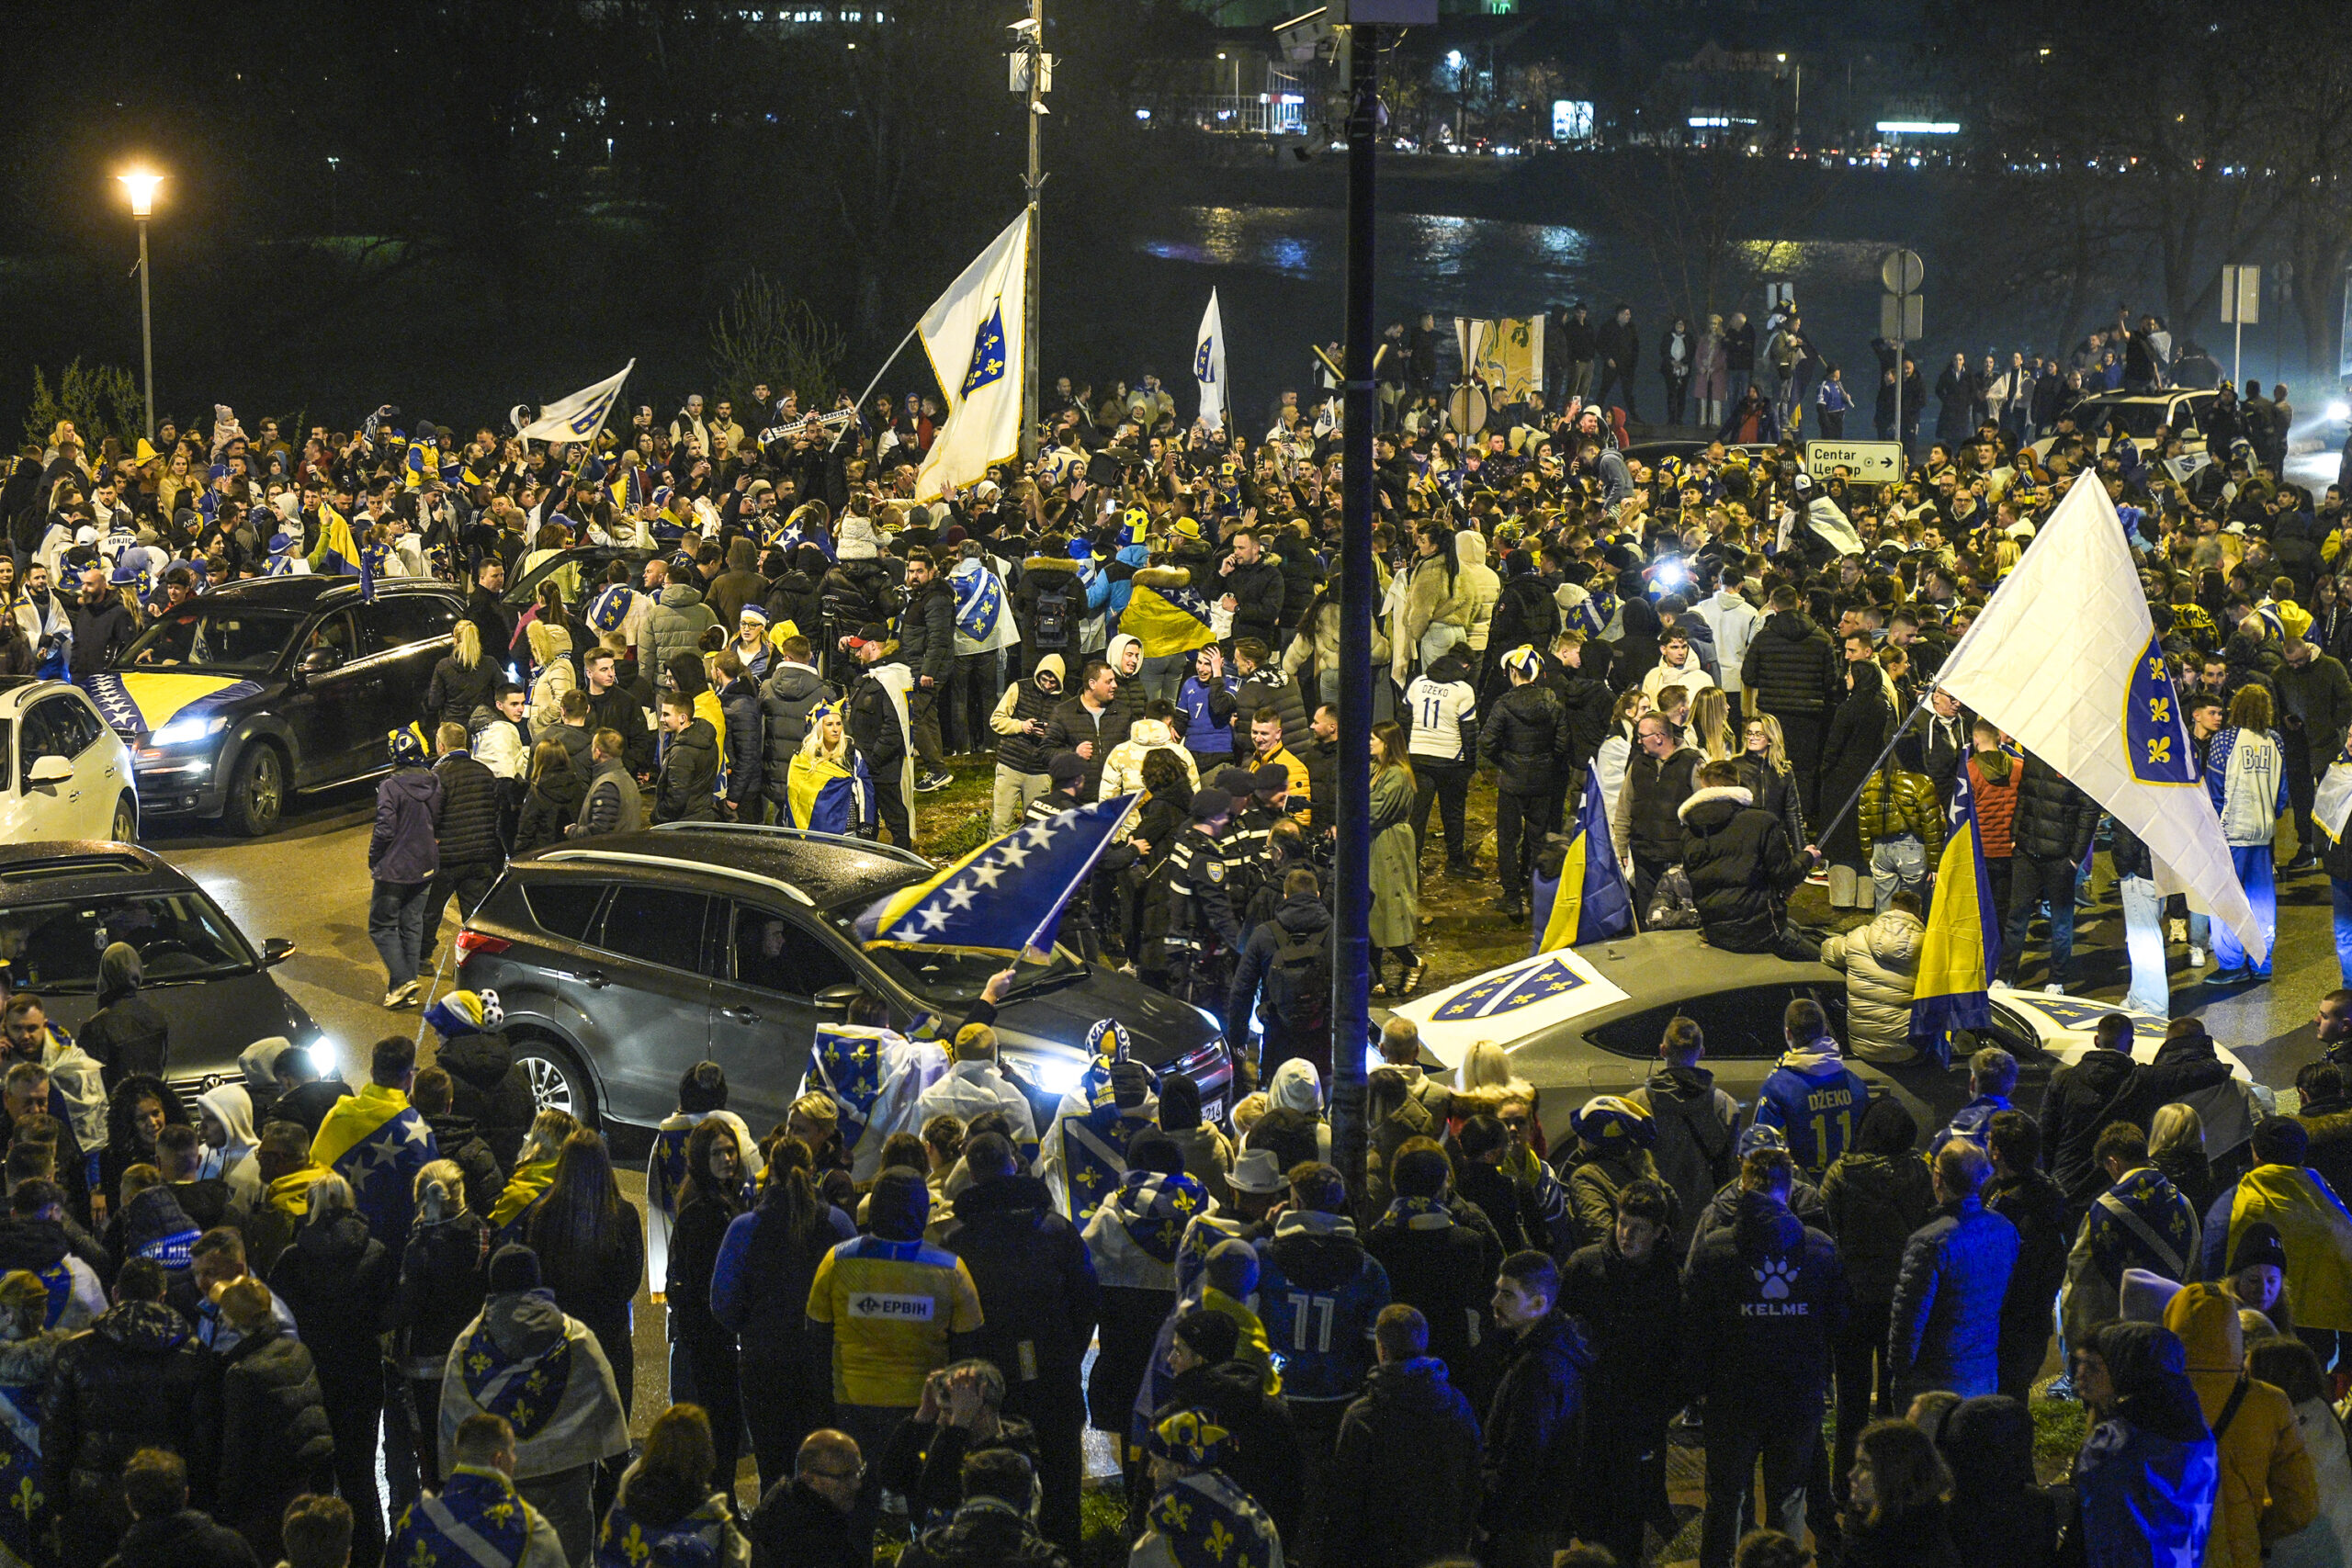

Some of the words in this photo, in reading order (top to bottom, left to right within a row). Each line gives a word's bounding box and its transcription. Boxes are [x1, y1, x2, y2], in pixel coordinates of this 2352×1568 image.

[1815, 448, 1857, 460] Centar
[1194, 702, 1204, 719] 7
[1423, 697, 1441, 729] 11
[2241, 745, 2271, 770] BiH
[1807, 1089, 1852, 1111] DŽEKO
[1810, 1110, 1851, 1169] 11
[883, 1300, 927, 1315] EPBIH
[1741, 1303, 1809, 1316] KELME
